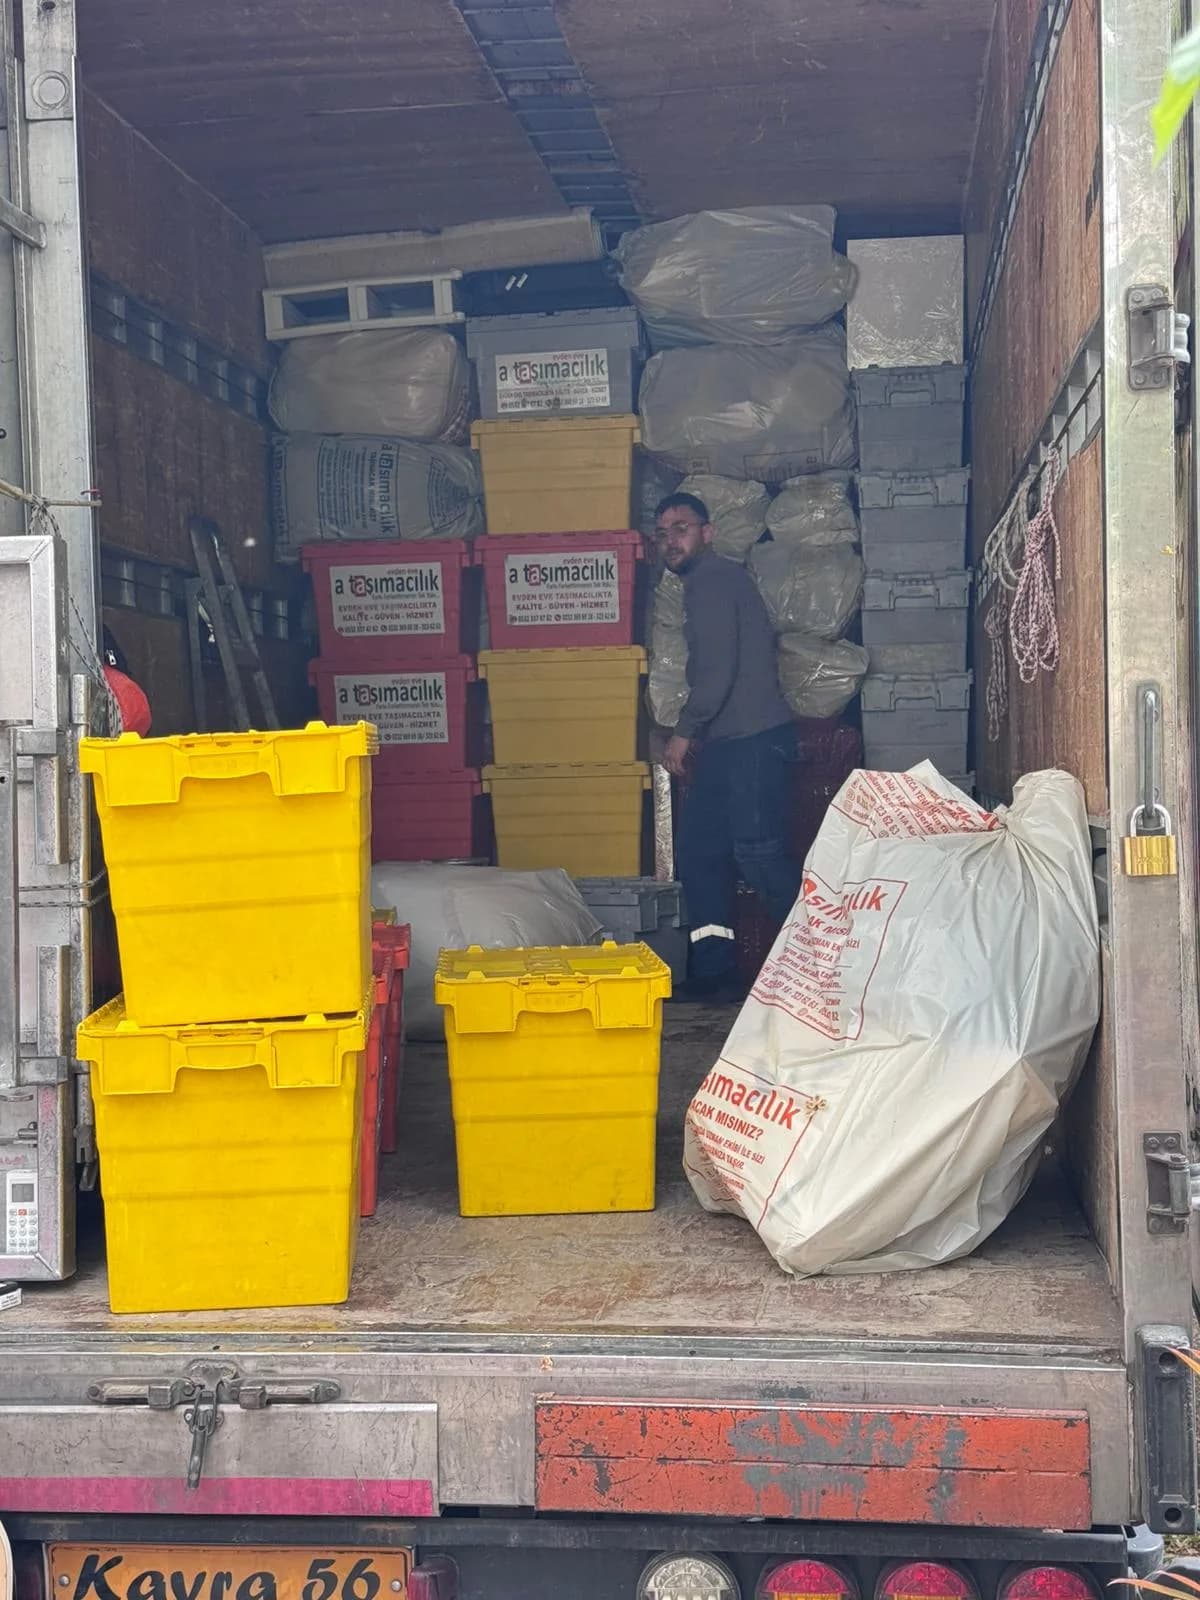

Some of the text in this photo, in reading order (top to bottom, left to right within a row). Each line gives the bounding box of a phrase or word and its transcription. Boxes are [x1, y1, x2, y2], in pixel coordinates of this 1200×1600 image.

[499, 365, 508, 381] a
[509, 558, 615, 586] a taşımacılık
[335, 569, 439, 597] a taşımacılık
[512, 593, 538, 601] EVDEN
[549, 602, 575, 610] GÜVEN
[374, 613, 400, 621] GÜVEN
[340, 679, 444, 706] a taşımacılık
[302, 1558, 381, 1600] 56
